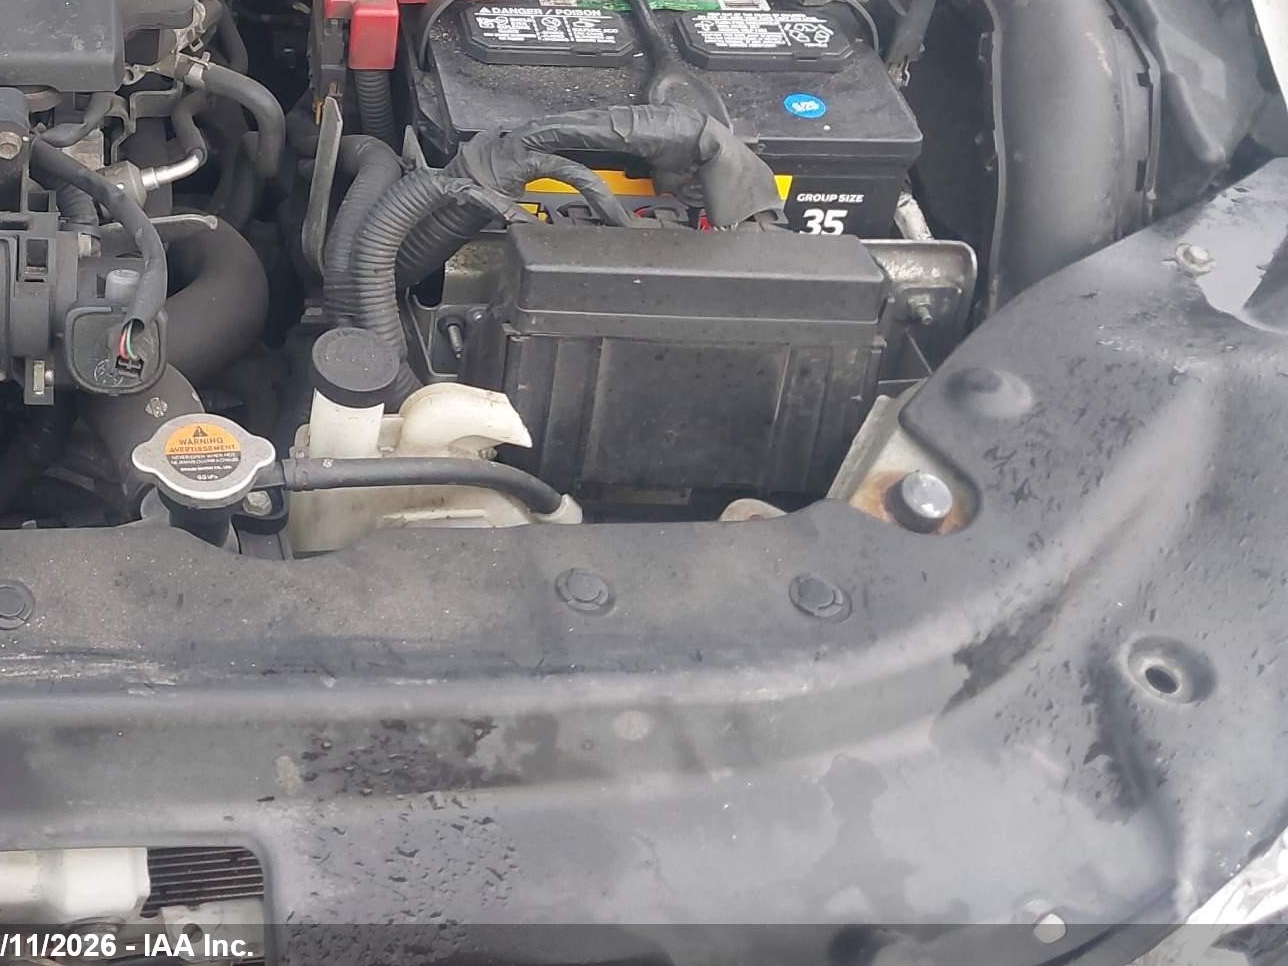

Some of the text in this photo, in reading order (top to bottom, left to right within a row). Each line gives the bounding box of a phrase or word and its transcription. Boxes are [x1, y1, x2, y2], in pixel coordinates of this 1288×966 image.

[492, 7, 543, 16] DANGER
[555, 8, 601, 17] POISON
[796, 193, 865, 203] GROUP SIZE
[799, 208, 848, 235] 35
[178, 436, 224, 446] WARNING
[169, 444, 235, 453] AVERTISSEMENT
